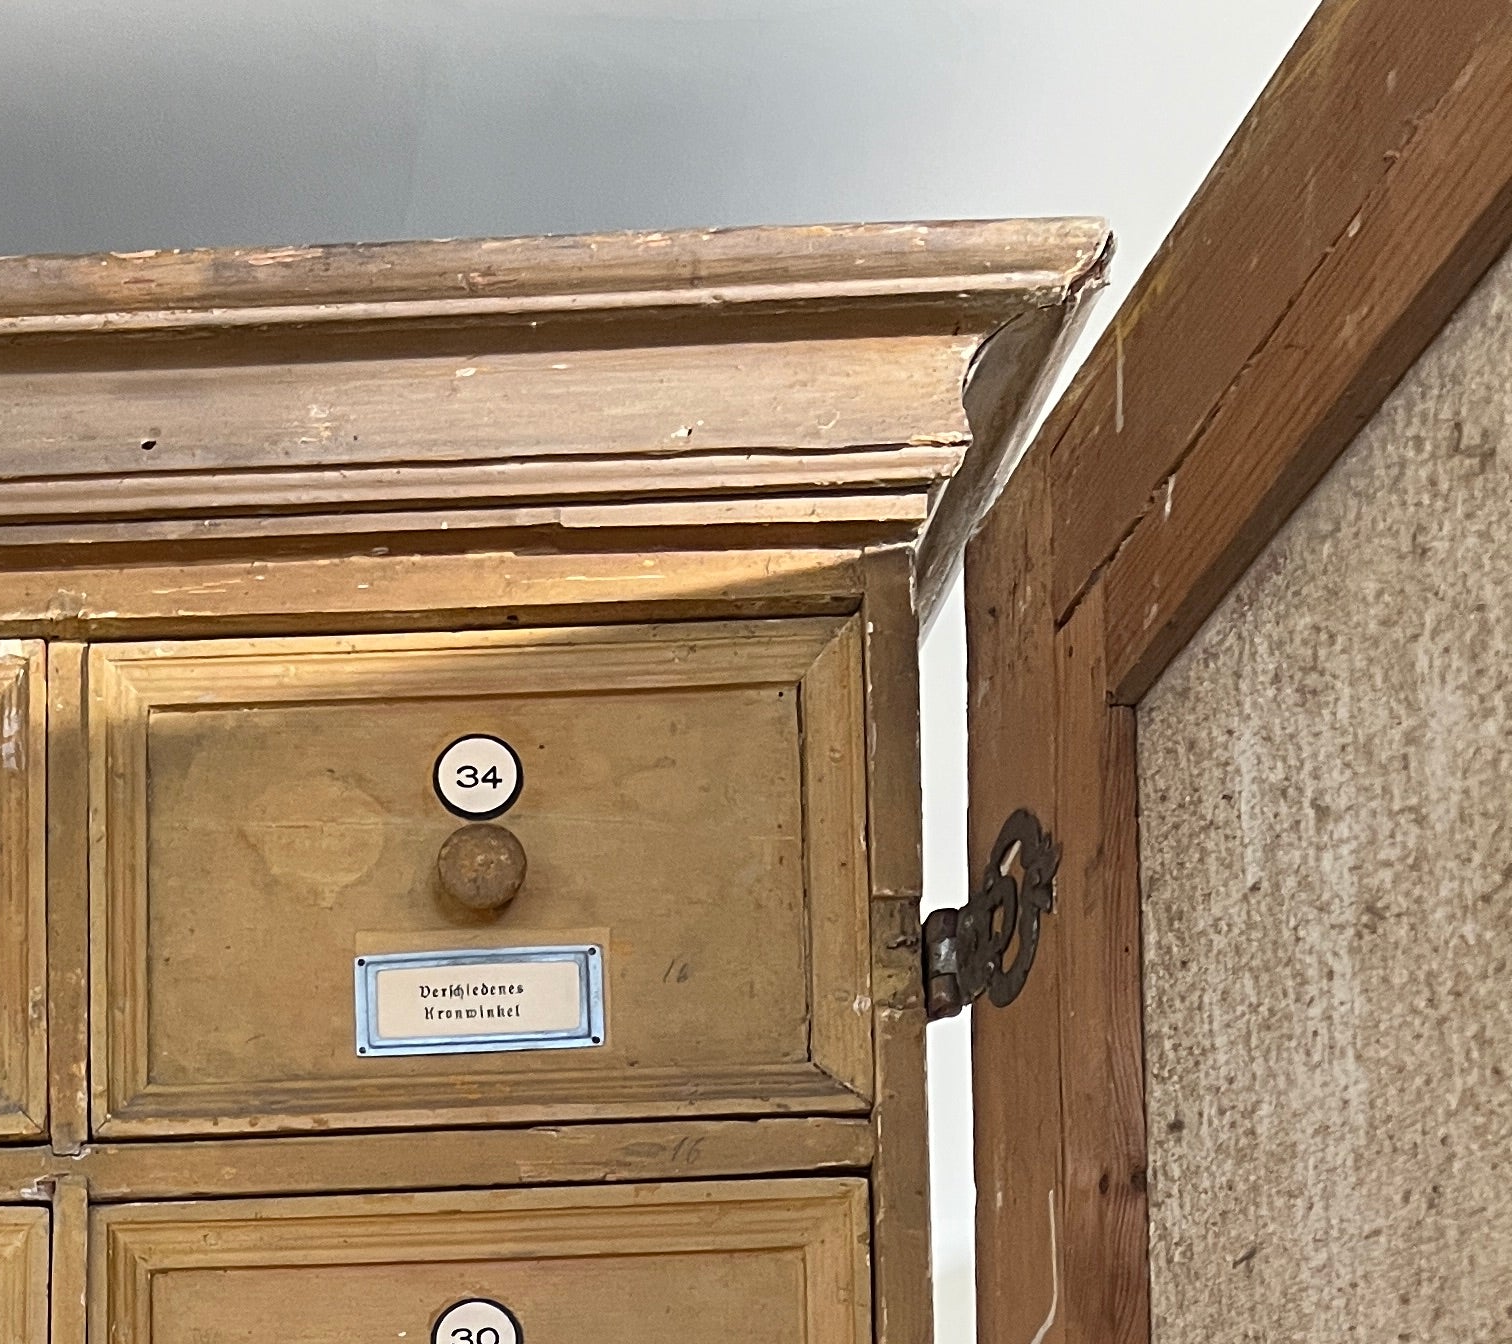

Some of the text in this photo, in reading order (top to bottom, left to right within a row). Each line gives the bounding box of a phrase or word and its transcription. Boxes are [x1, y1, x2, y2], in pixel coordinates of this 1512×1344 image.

[456, 765, 503, 790] 34
[418, 982, 525, 1000] Verschiedenes
[424, 1004, 520, 1021] Kronwinkel
